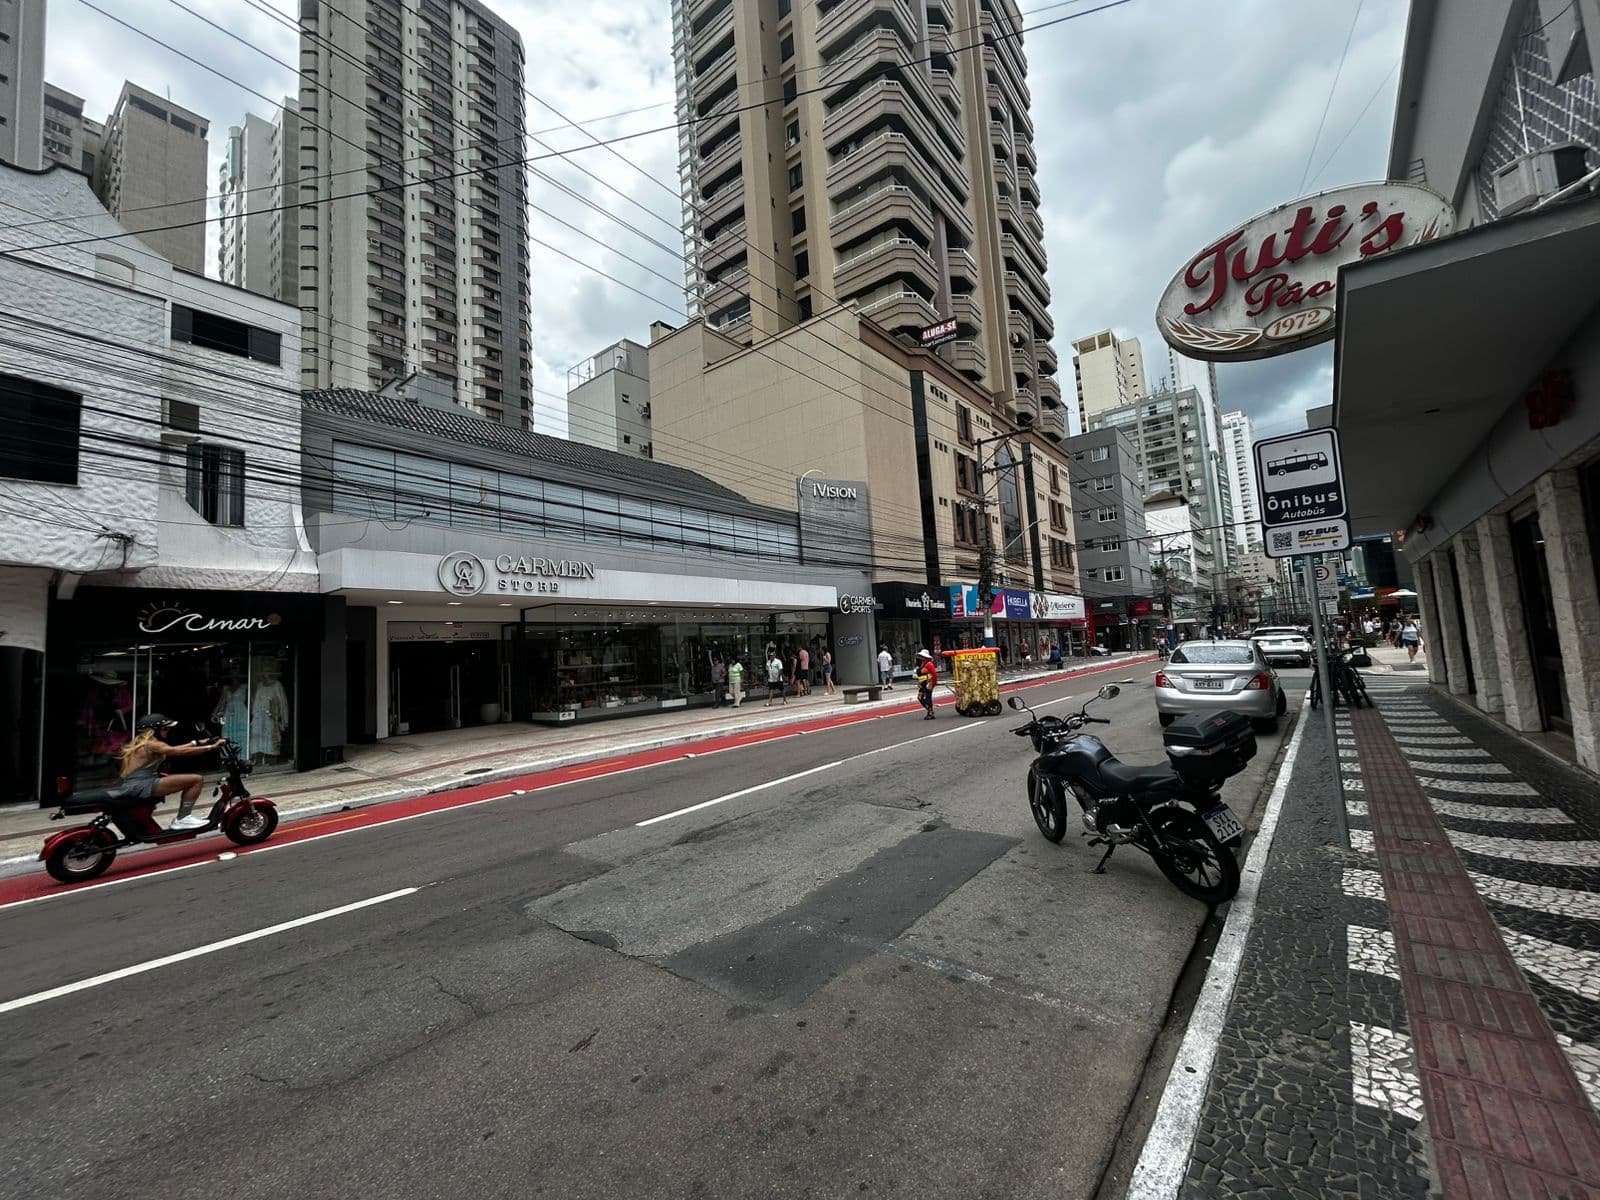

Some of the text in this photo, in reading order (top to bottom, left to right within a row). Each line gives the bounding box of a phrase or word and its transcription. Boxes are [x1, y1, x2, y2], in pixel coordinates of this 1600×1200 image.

[1183, 201, 1405, 315] Tuti's
[1245, 273, 1335, 317] Pão
[922, 320, 957, 340] ALUGA-SE
[1273, 308, 1321, 336] 1972
[1267, 492, 1338, 511] Ônibus
[1281, 506, 1326, 520] Autobús
[1316, 526, 1339, 535] BUS
[495, 554, 597, 578] CARMEN
[498, 579, 560, 592] STORE
[851, 595, 876, 605] CARMEN
[851, 605, 871, 613] SPORTS
[1217, 820, 1242, 840] 2112
